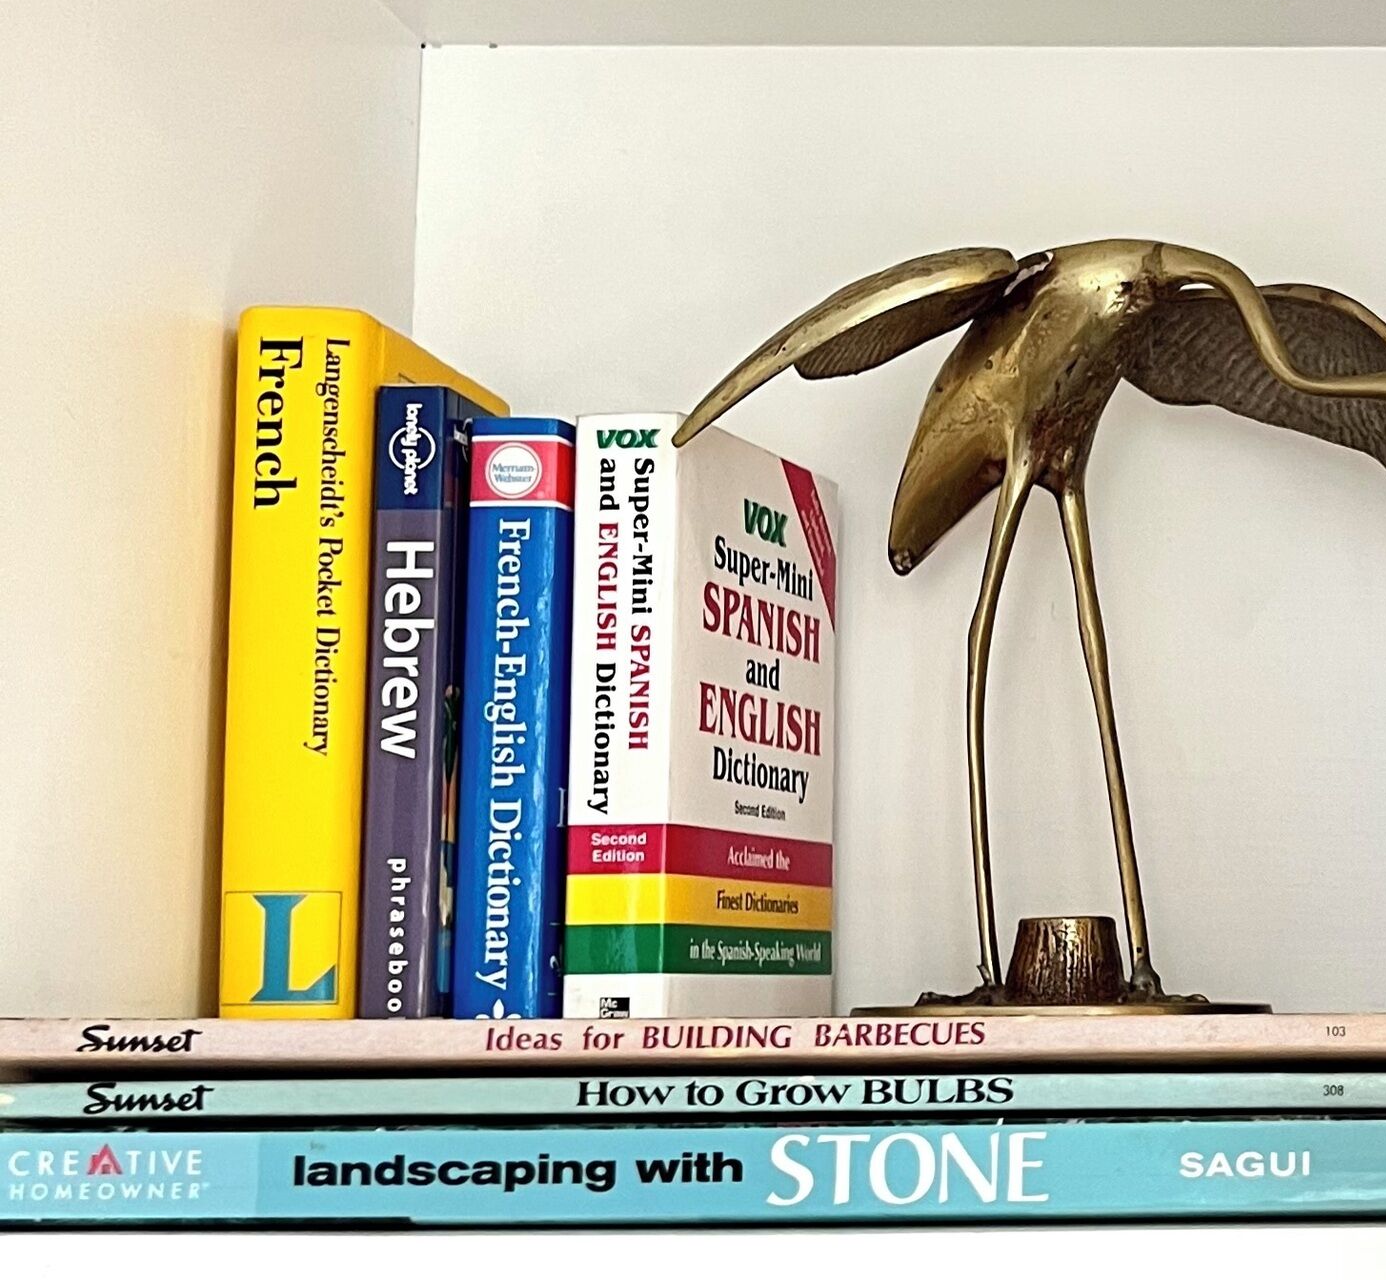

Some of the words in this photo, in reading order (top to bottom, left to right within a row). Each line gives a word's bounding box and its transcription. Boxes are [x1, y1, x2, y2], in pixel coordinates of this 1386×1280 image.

[253, 336, 304, 509] French
[313, 338, 351, 528] Langenscheidt's
[597, 459, 620, 510] and
[314, 537, 345, 620] Pocket
[595, 522, 620, 651] ENGLISH
[629, 458, 656, 616] Super-Mini
[380, 540, 435, 760] Hebrew
[482, 519, 530, 791] French-English
[703, 580, 821, 663] SPANISH
[304, 627, 343, 757] Dictionary
[587, 662, 617, 816] Dictionary
[628, 624, 652, 751] SPANISH
[699, 684, 821, 757] ENGLISH
[712, 746, 810, 801] Dictionary
[474, 798, 525, 990] Dictionary
[485, 1027, 562, 1051] Ideas
[582, 1027, 623, 1051] for
[642, 1024, 792, 1050] BUILDING
[814, 1022, 986, 1046] BARBECUES
[1325, 1025, 1346, 1038] 103
[577, 1080, 676, 1108] How
[684, 1081, 724, 1107] to
[735, 1080, 850, 1107] Grow
[861, 1078, 1014, 1106] BULBS
[1322, 1083, 1344, 1096] 308
[293, 1154, 616, 1192] landscaping
[635, 1151, 743, 1184] with
[765, 1132, 1048, 1205] STONE
[1179, 1151, 1311, 1177] SAGUI
